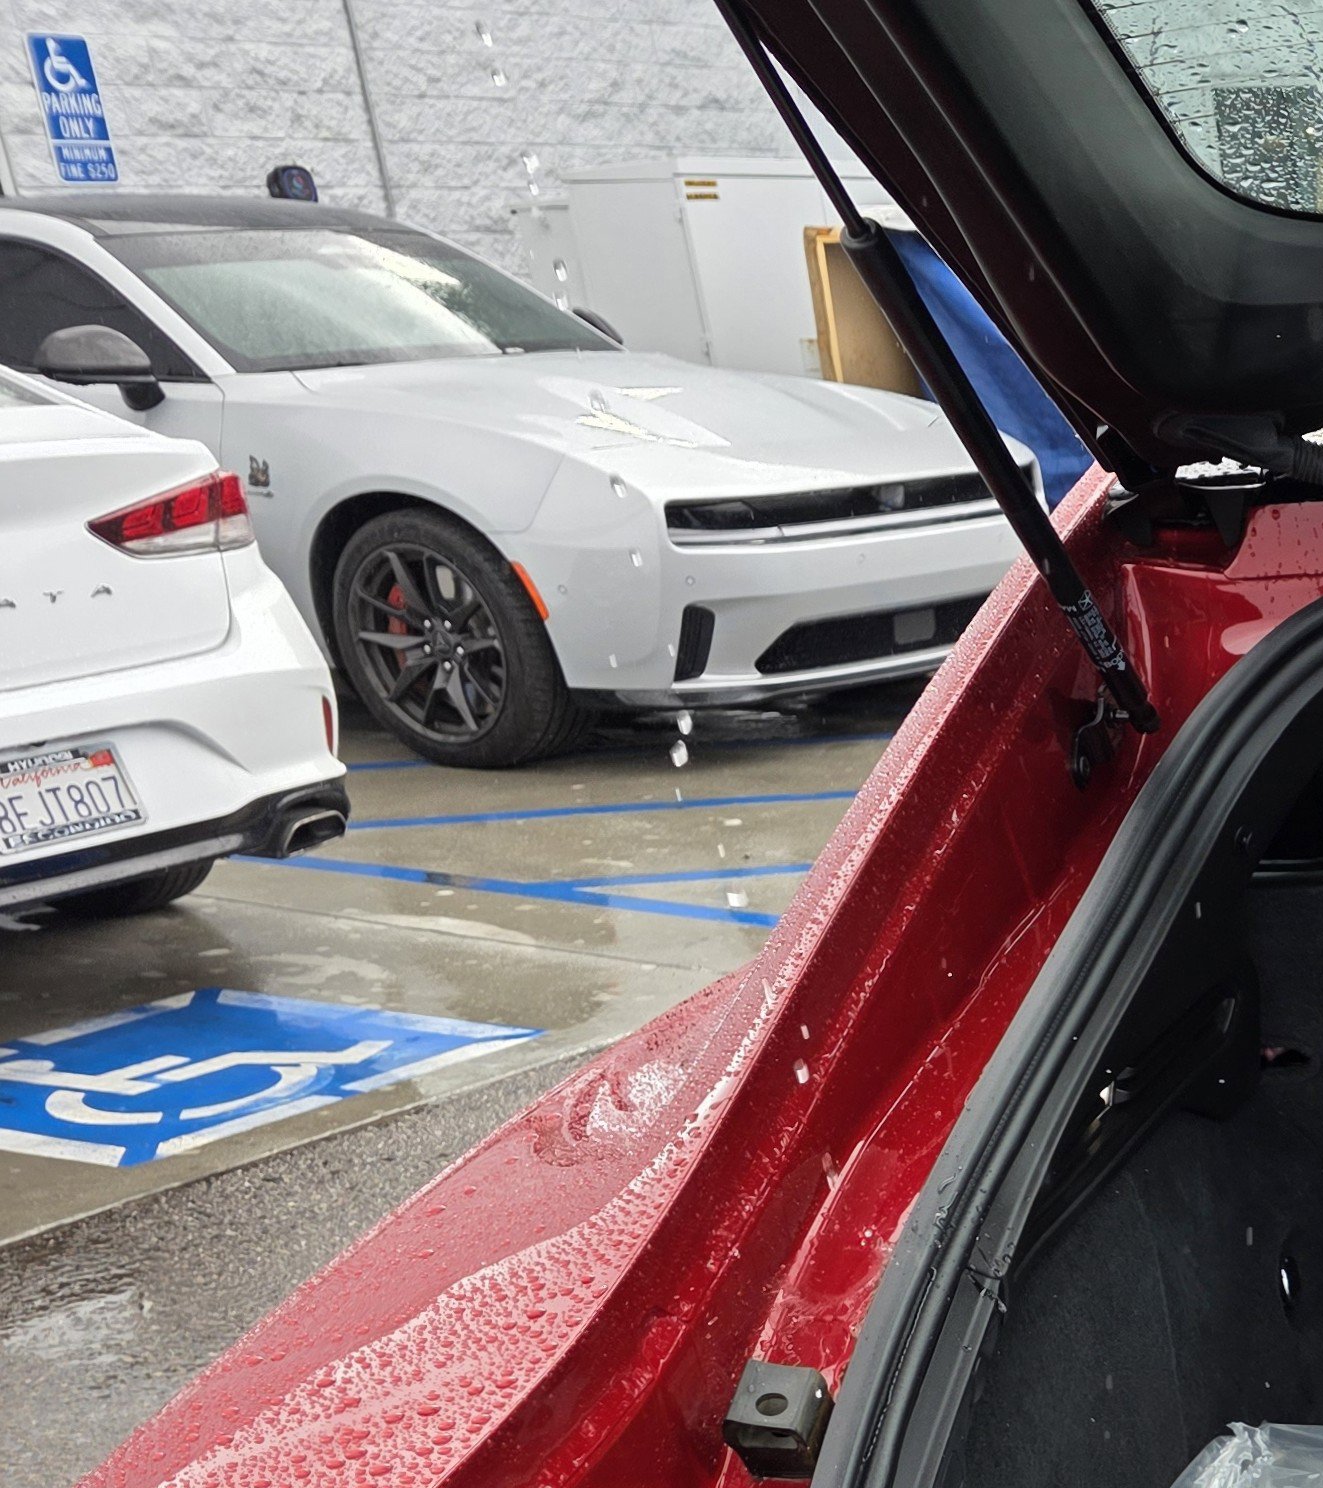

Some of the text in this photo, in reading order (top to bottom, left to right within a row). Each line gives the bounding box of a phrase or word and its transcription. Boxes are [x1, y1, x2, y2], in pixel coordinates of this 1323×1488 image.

[41, 92, 102, 117] PARKING
[58, 115, 95, 138] ONLY
[61, 145, 107, 161] MINIMUM
[60, 162, 117, 179] FINE $250
